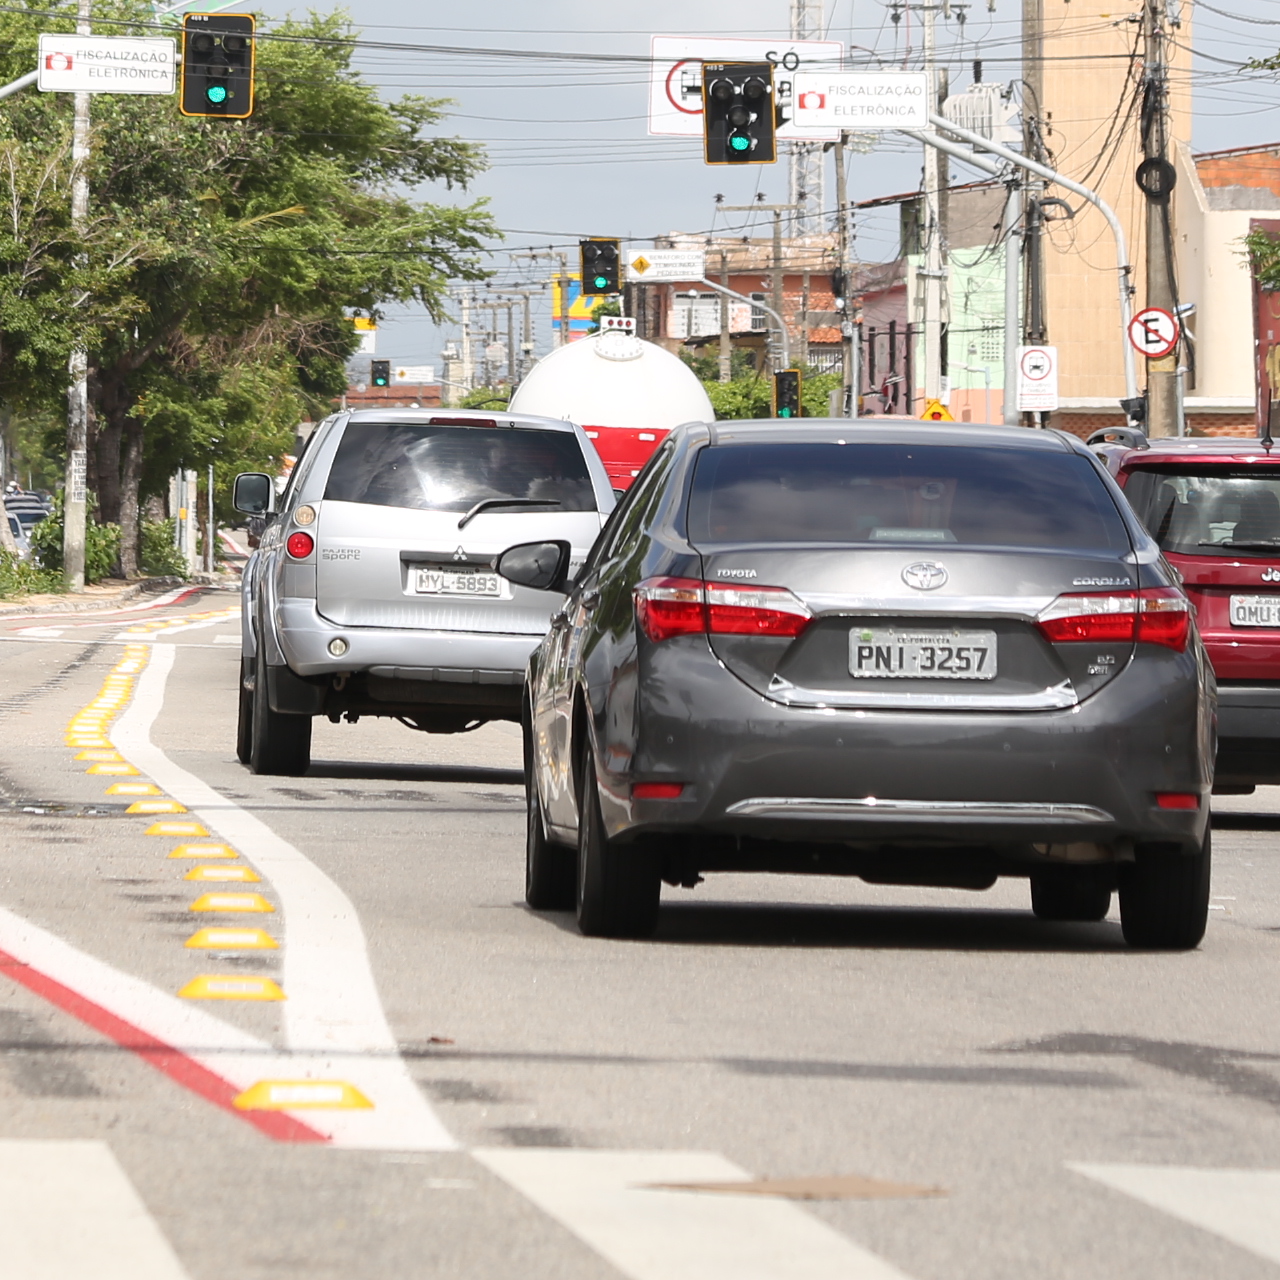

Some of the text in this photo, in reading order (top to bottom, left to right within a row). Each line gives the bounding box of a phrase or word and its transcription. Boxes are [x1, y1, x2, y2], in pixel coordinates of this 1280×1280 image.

[76, 49, 168, 64] FISCALIZAÇÃO
[765, 46, 800, 71] SÓ
[88, 65, 168, 80] ELETRÔNICA
[828, 83, 923, 98] FISCALIZAÇÃO
[833, 103, 916, 116] ELETRÔNICA
[717, 569, 757, 578] TOYOTA
[1073, 577, 1131, 586] COROLLA
